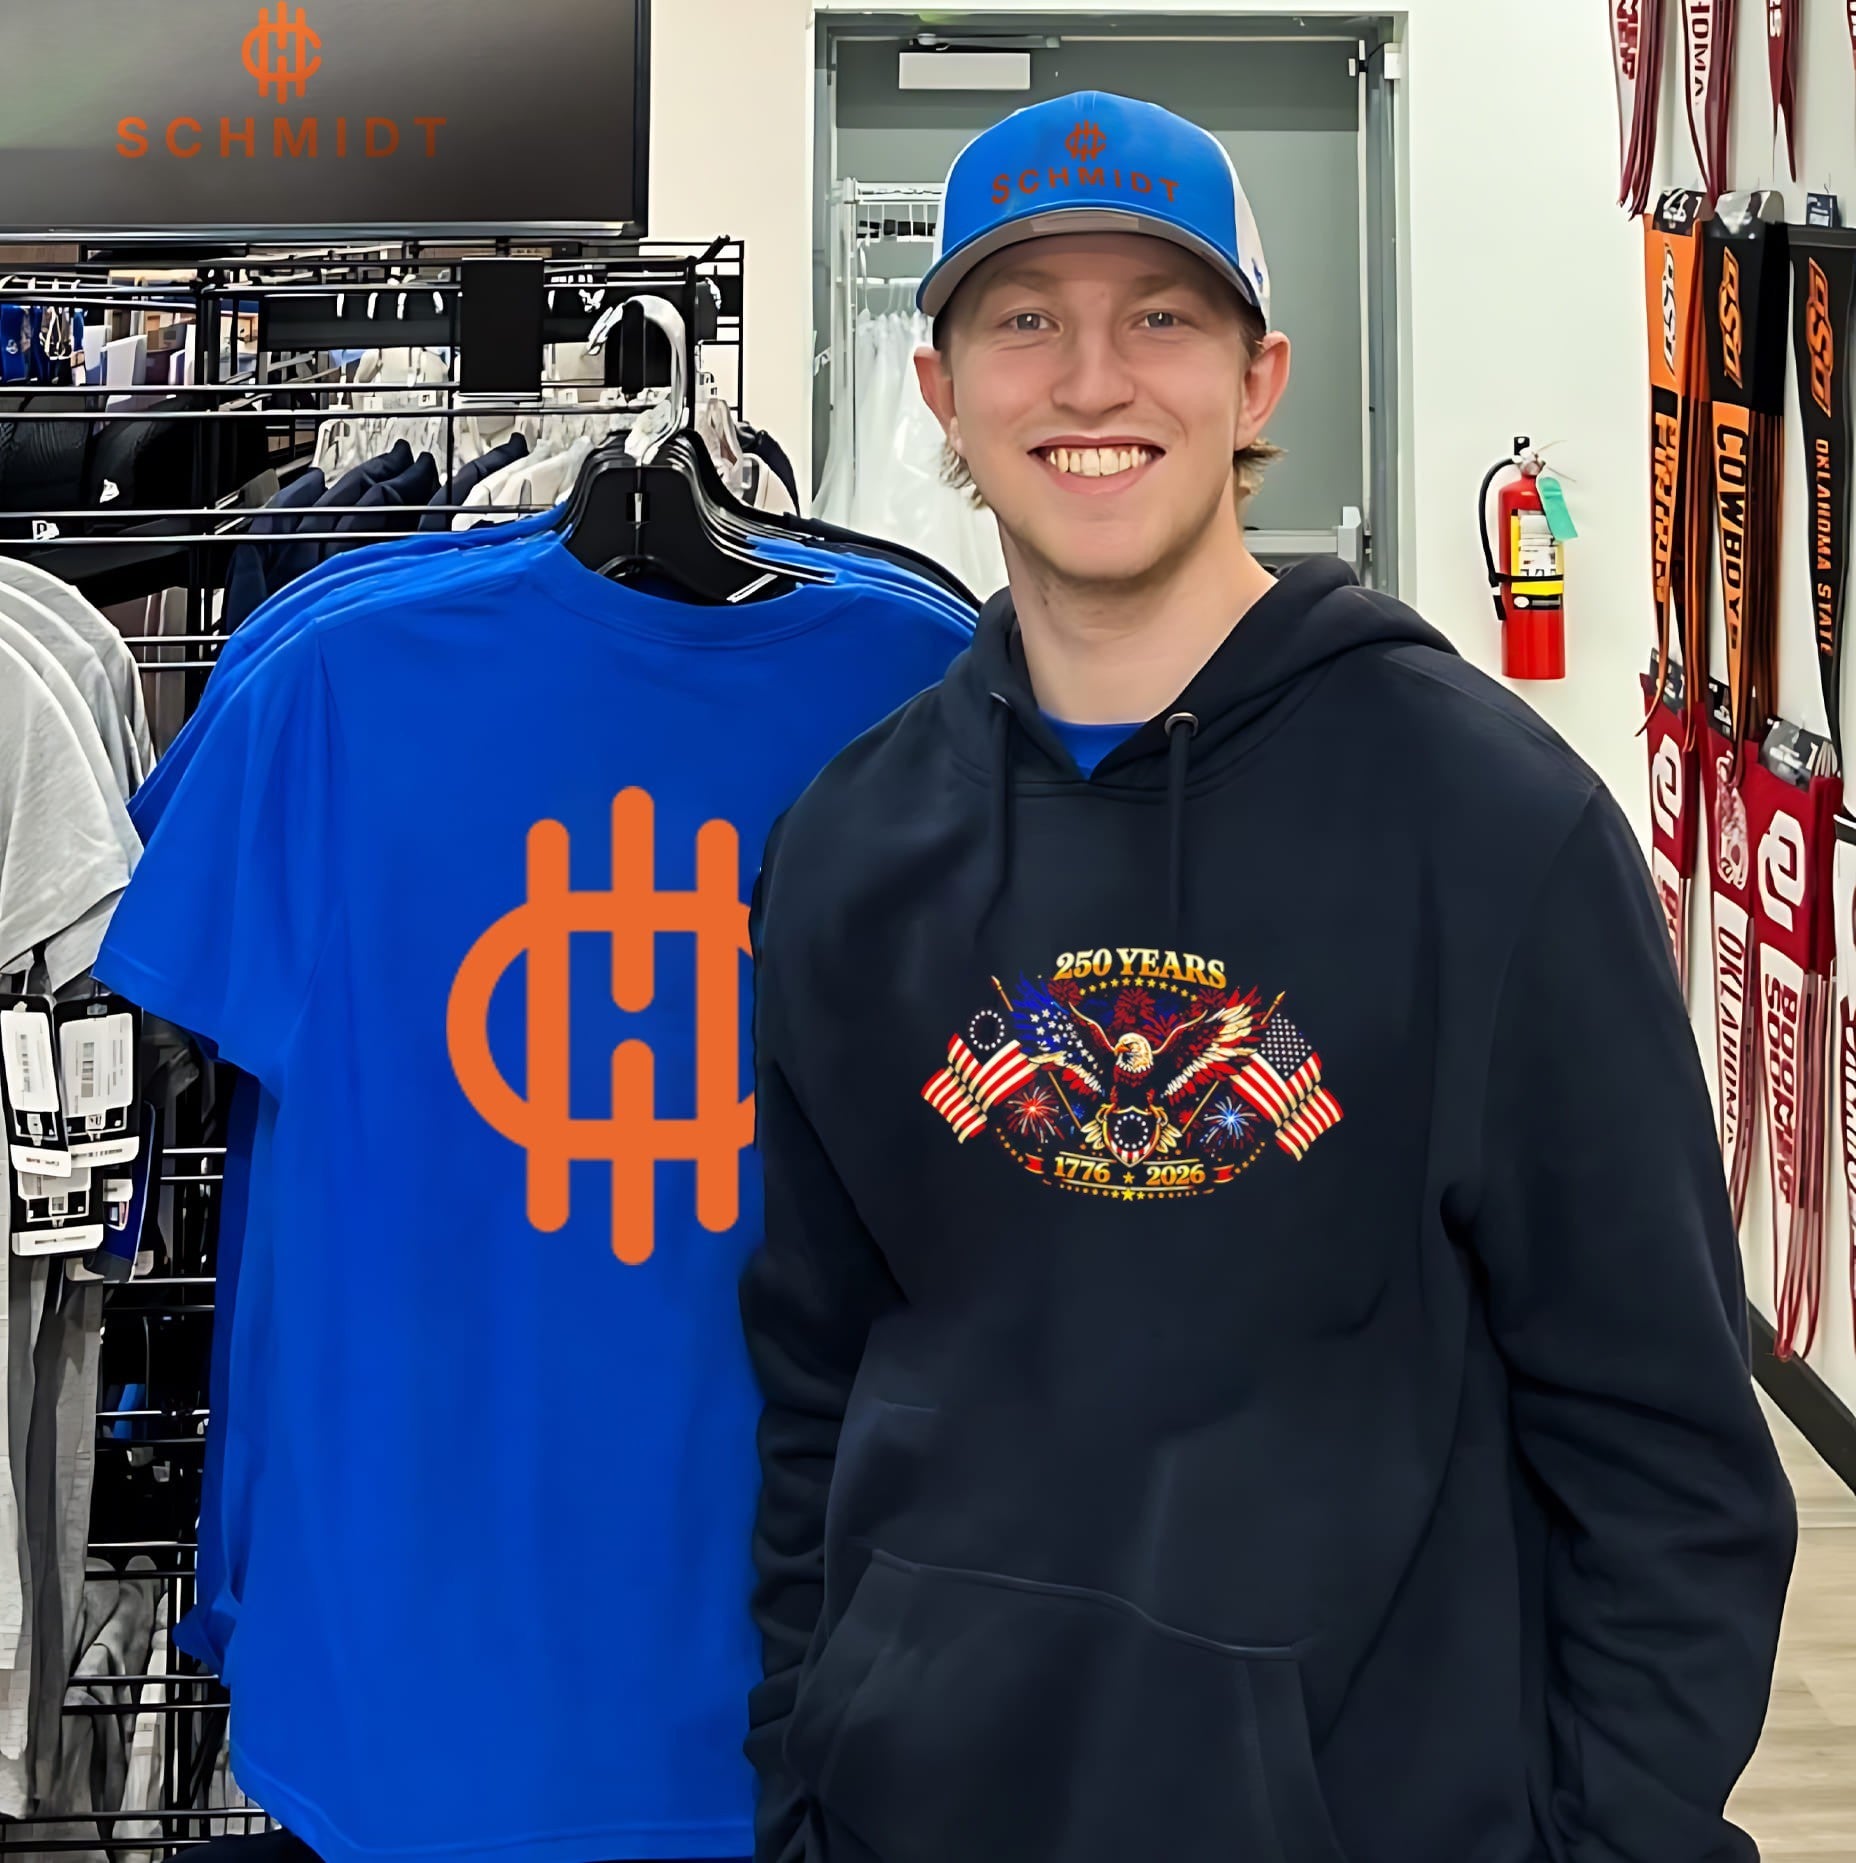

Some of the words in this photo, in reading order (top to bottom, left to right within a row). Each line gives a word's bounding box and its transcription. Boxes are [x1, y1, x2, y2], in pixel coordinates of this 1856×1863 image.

[115, 116, 447, 159] SCHMIDT
[991, 166, 1179, 205] SCHMIDT
[1804, 256, 1834, 419] OSU
[1814, 438, 1832, 570] OKLAHOMA
[1651, 733, 1682, 839] OU
[1757, 808, 1806, 933] OU
[1053, 948, 1112, 981] 250
[1116, 947, 1227, 989] YEARS
[1717, 925, 1746, 1144] OKLAHOMA
[1053, 1155, 1111, 1184] 1776
[1146, 1162, 1206, 1186] 2026
